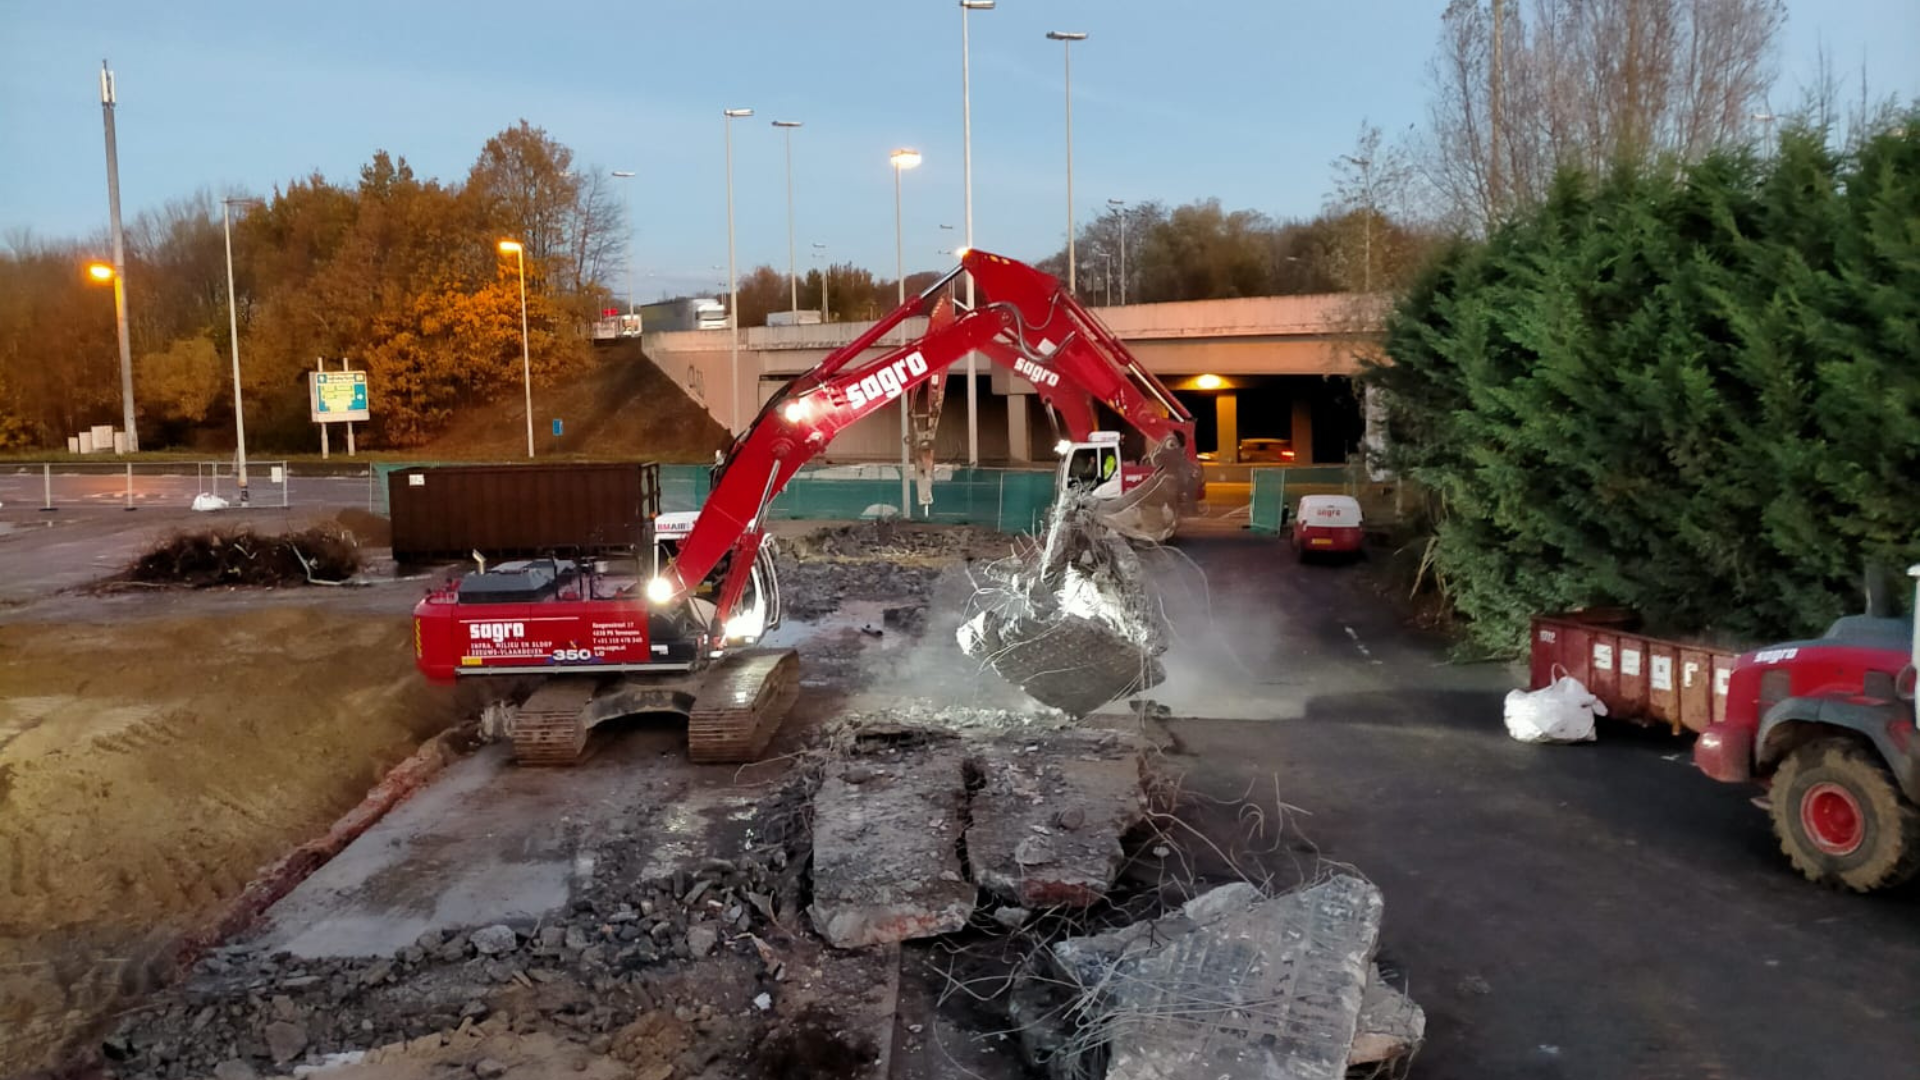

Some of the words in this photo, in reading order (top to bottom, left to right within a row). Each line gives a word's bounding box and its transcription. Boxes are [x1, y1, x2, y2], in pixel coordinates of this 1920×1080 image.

[845, 350, 929, 411] sagro
[1014, 356, 1061, 388] sagro
[469, 622, 525, 643] sagro
[553, 648, 592, 661] 350
[1752, 647, 1799, 665] sagro
